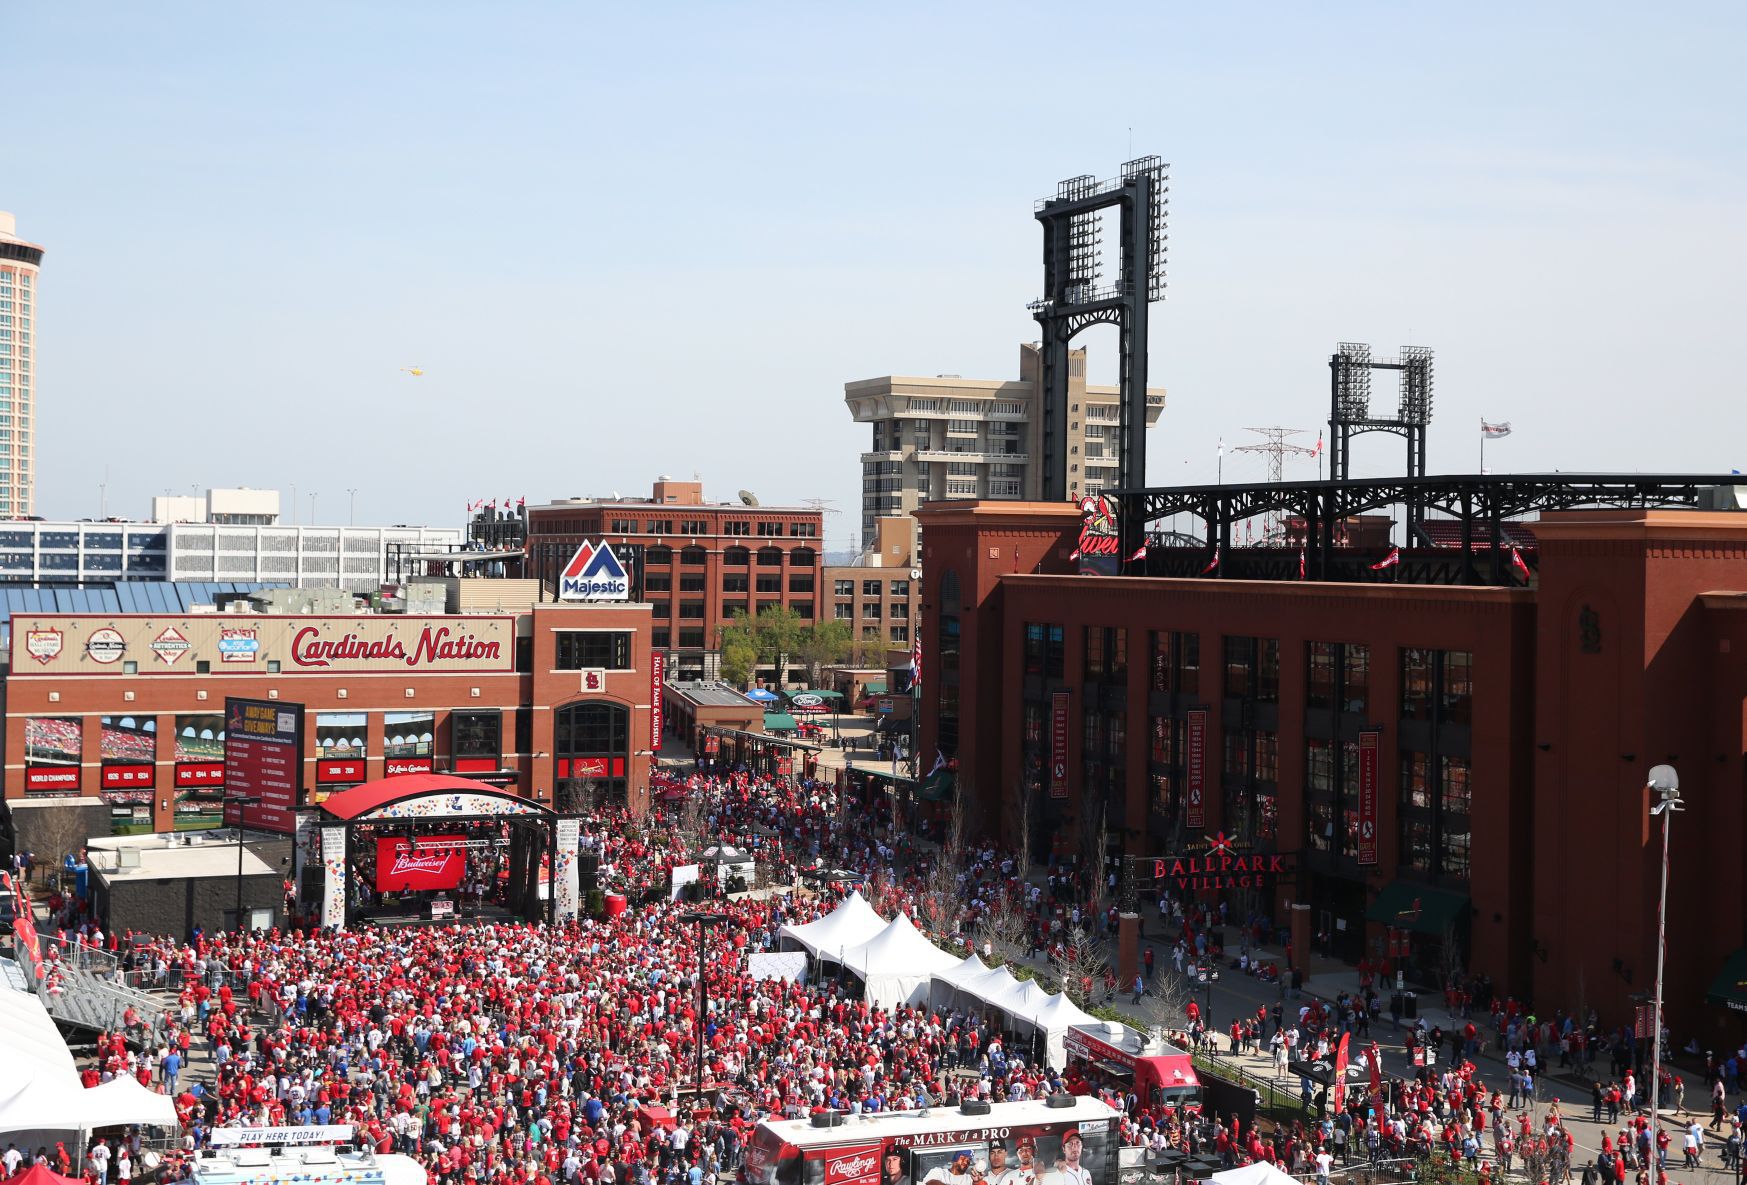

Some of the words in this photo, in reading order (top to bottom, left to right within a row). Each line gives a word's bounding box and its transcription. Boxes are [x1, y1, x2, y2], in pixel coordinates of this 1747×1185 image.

[563, 579, 625, 596] Majestic
[291, 626, 404, 667] Cardinals
[406, 626, 501, 667] Nation
[653, 656, 661, 676] HALL
[653, 676, 660, 687] OF
[246, 706, 260, 718] AWAY
[260, 707, 276, 720] GAME
[244, 720, 276, 735] GIVEAWAYS
[652, 715, 660, 747] MUSEUM
[48, 774, 76, 782] CHAMPIONS
[396, 857, 446, 869] Budweiser
[1153, 855, 1286, 879] BALLPARK
[1177, 874, 1264, 890] VILLAGE
[1727, 1001, 1743, 1010] TEAM
[240, 1132, 264, 1142] PLAY
[266, 1132, 288, 1141] HERE
[291, 1131, 325, 1140] TODAY!
[894, 1136, 910, 1146] The
[913, 1131, 956, 1146] MARK
[959, 1130, 971, 1142] of
[981, 1128, 1011, 1140] PRO
[830, 1156, 877, 1178] Rawlings
